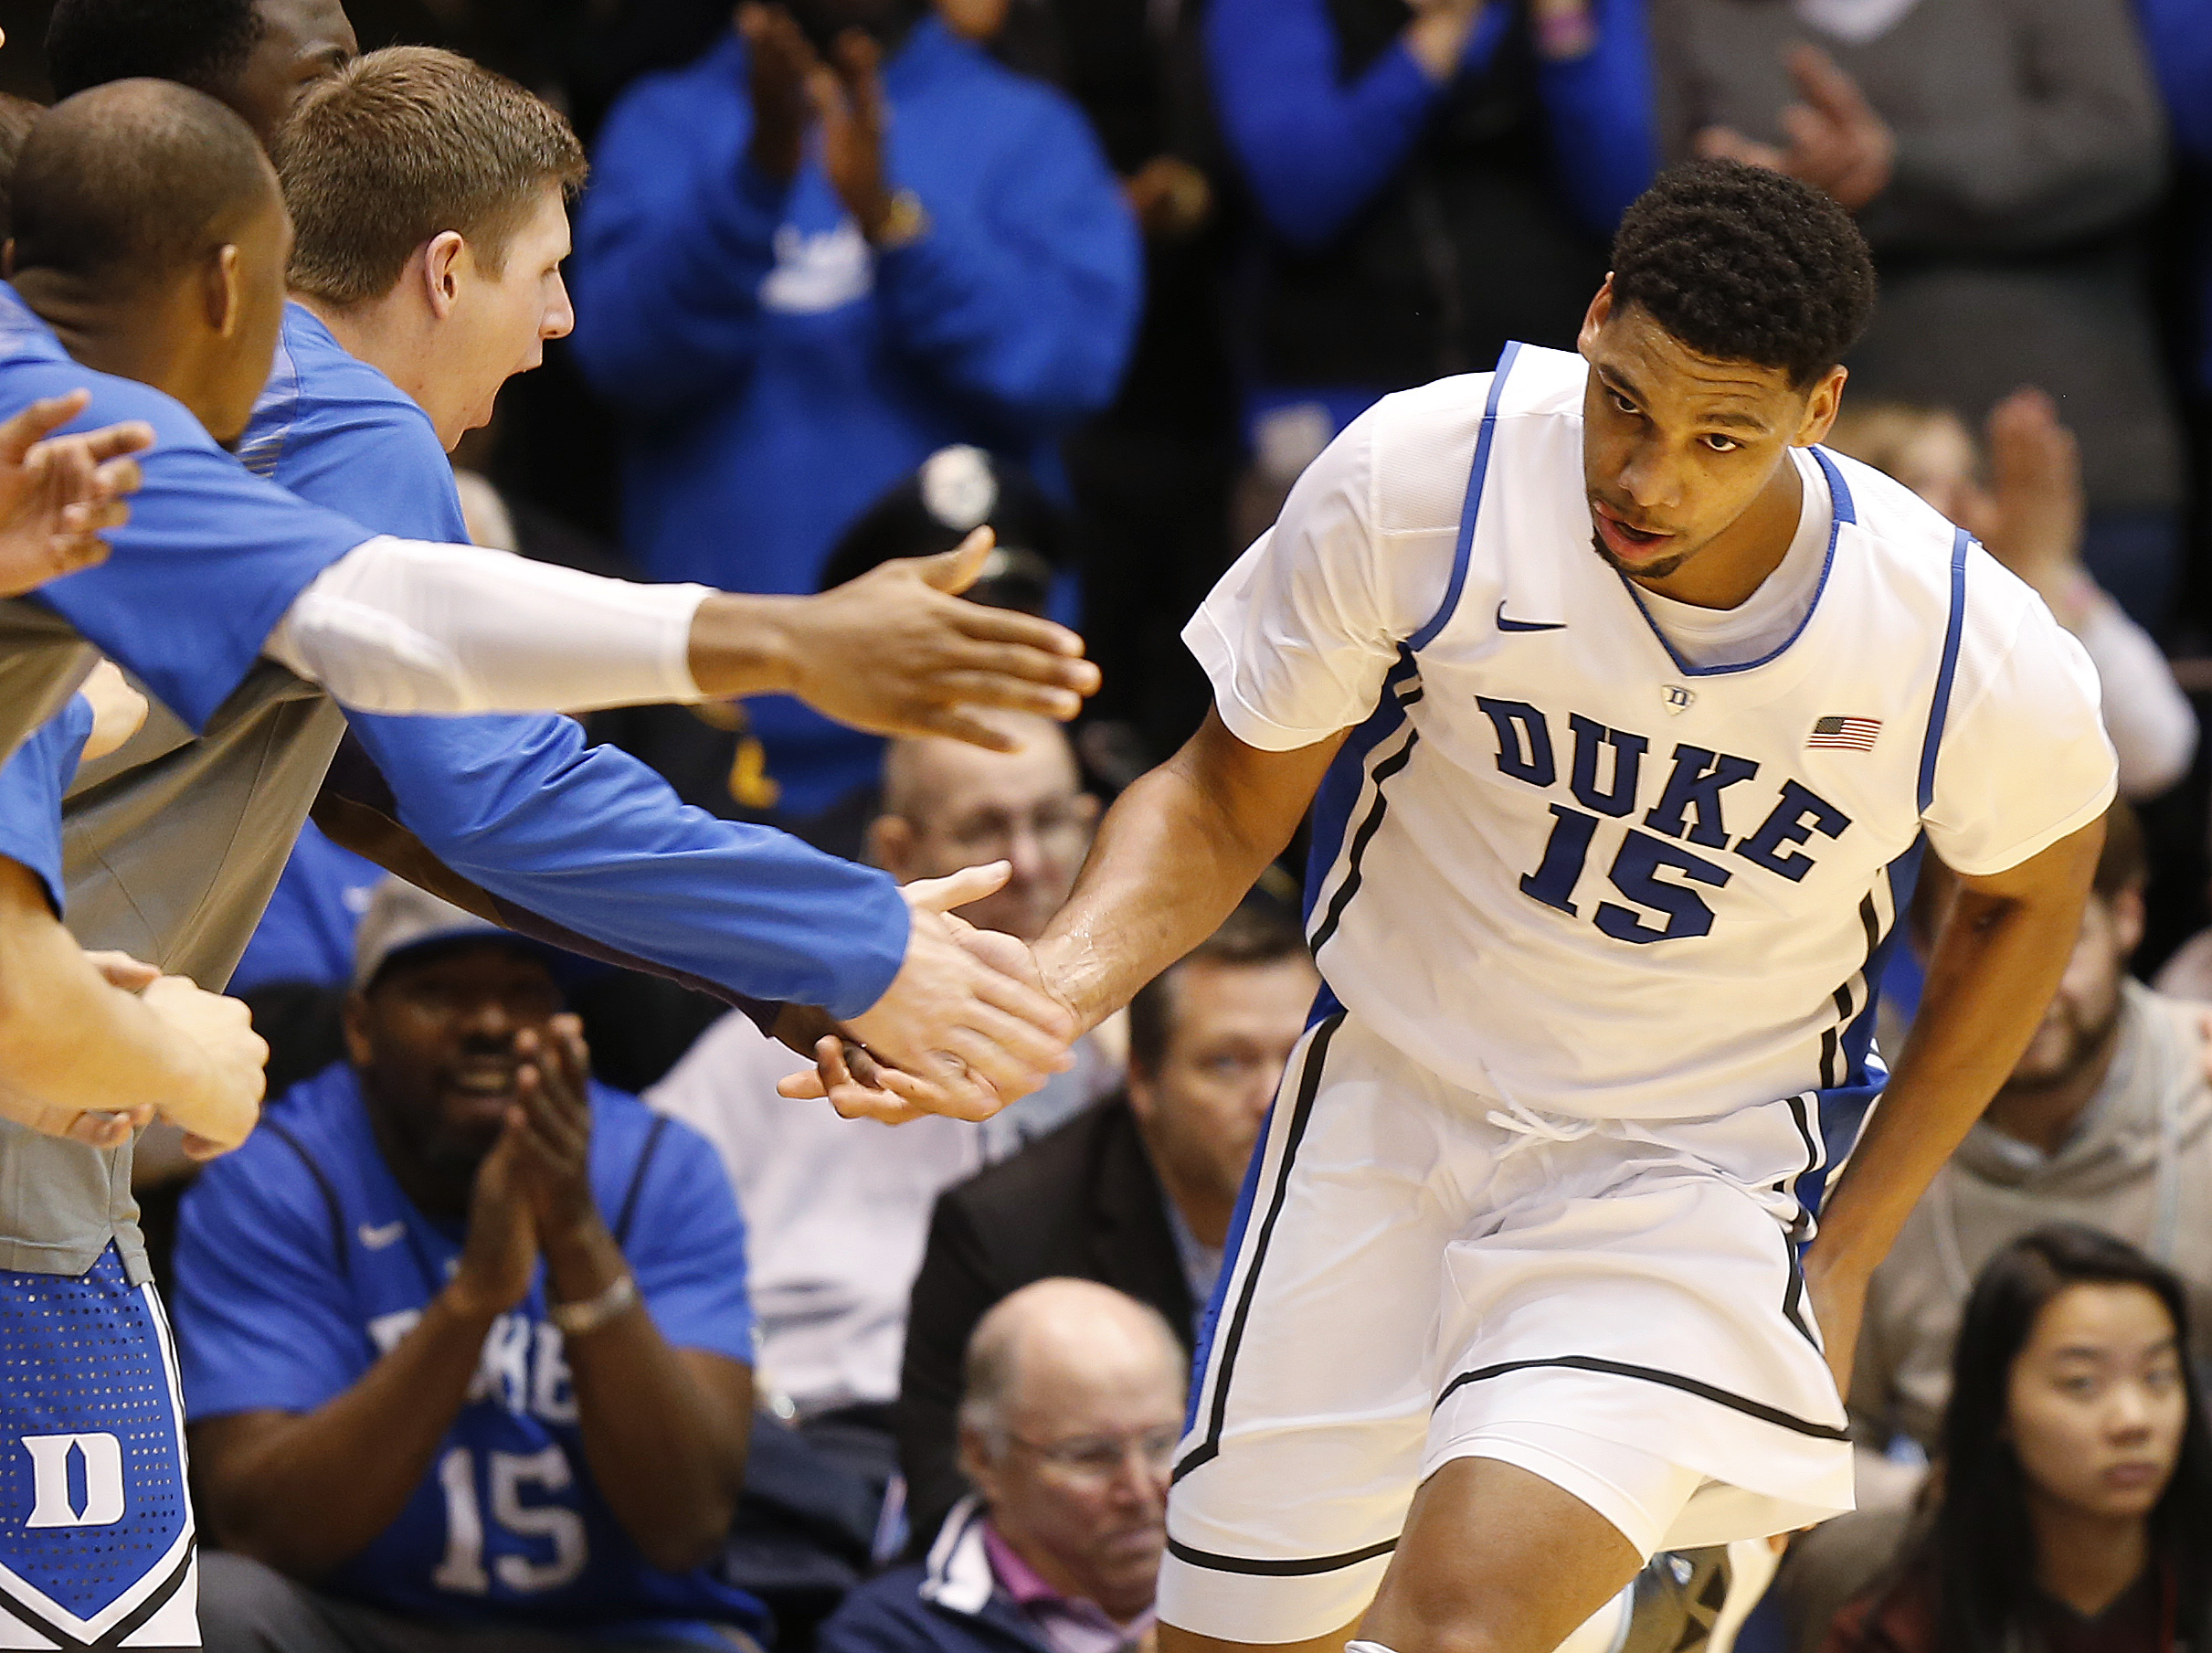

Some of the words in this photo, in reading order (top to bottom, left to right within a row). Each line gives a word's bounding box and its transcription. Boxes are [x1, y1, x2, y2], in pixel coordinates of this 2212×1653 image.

[1474, 694, 1853, 884] DUKE
[1519, 801, 1734, 945] 15
[20, 1432, 126, 1528] D
[432, 1445, 589, 1596] 15
